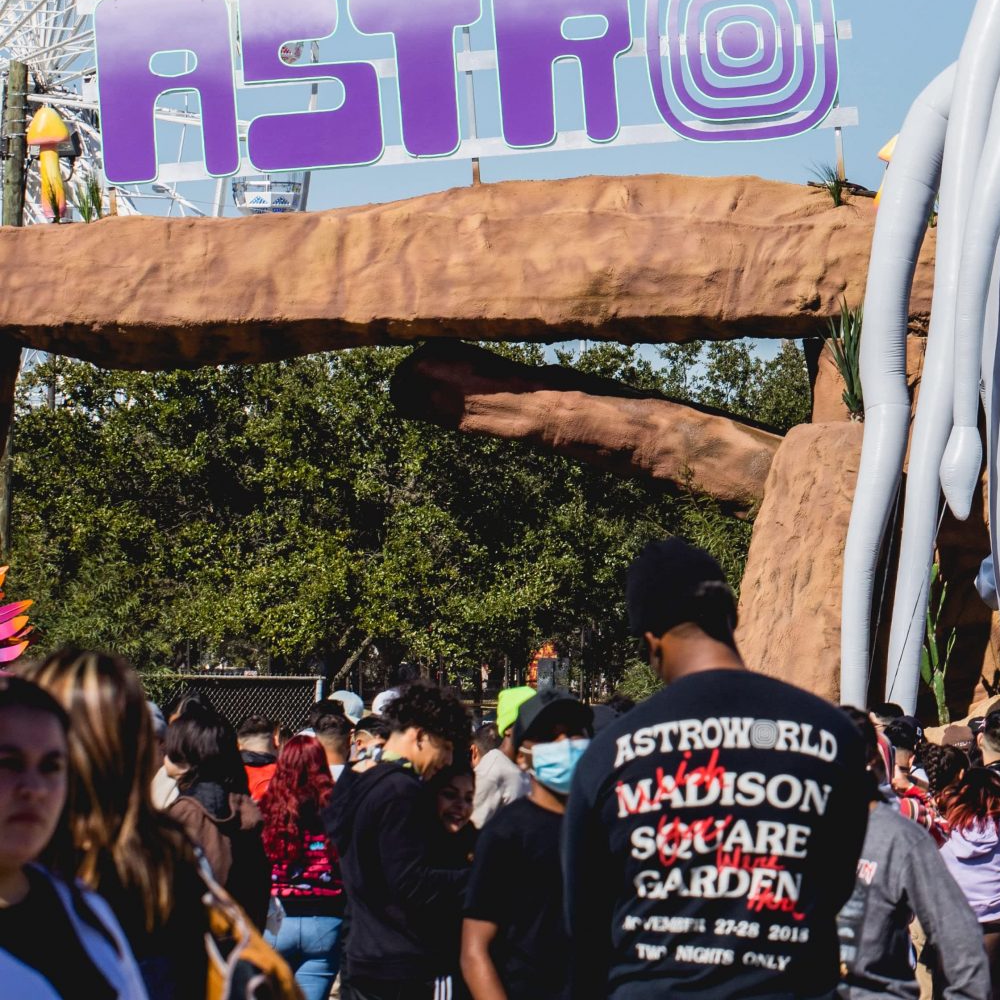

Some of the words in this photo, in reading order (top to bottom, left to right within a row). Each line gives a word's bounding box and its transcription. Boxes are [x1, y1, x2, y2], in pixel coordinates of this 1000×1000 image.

[613, 716, 838, 768] ASTROWORLD
[615, 771, 832, 818] MADISON
[630, 818, 812, 860] SQUARE
[633, 864, 803, 903] GARDEN
[675, 945, 734, 966] NIGHTS
[742, 951, 792, 971] ONLY
